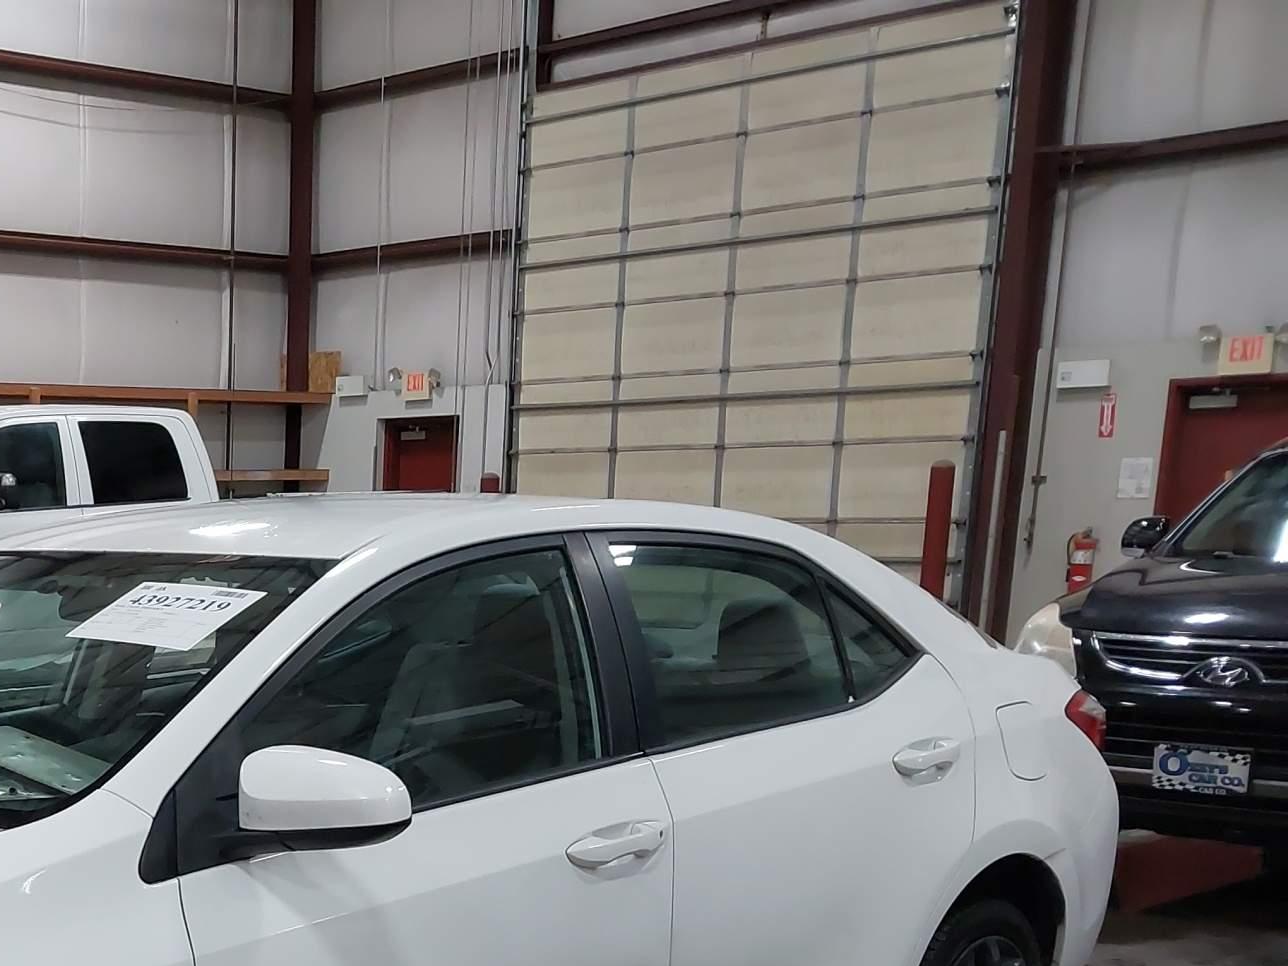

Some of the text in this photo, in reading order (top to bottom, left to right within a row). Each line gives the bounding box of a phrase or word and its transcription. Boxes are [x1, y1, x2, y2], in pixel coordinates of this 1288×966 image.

[1228, 335, 1265, 362] EXIT
[407, 373, 424, 391] EXIT
[129, 594, 232, 613] 43927219
